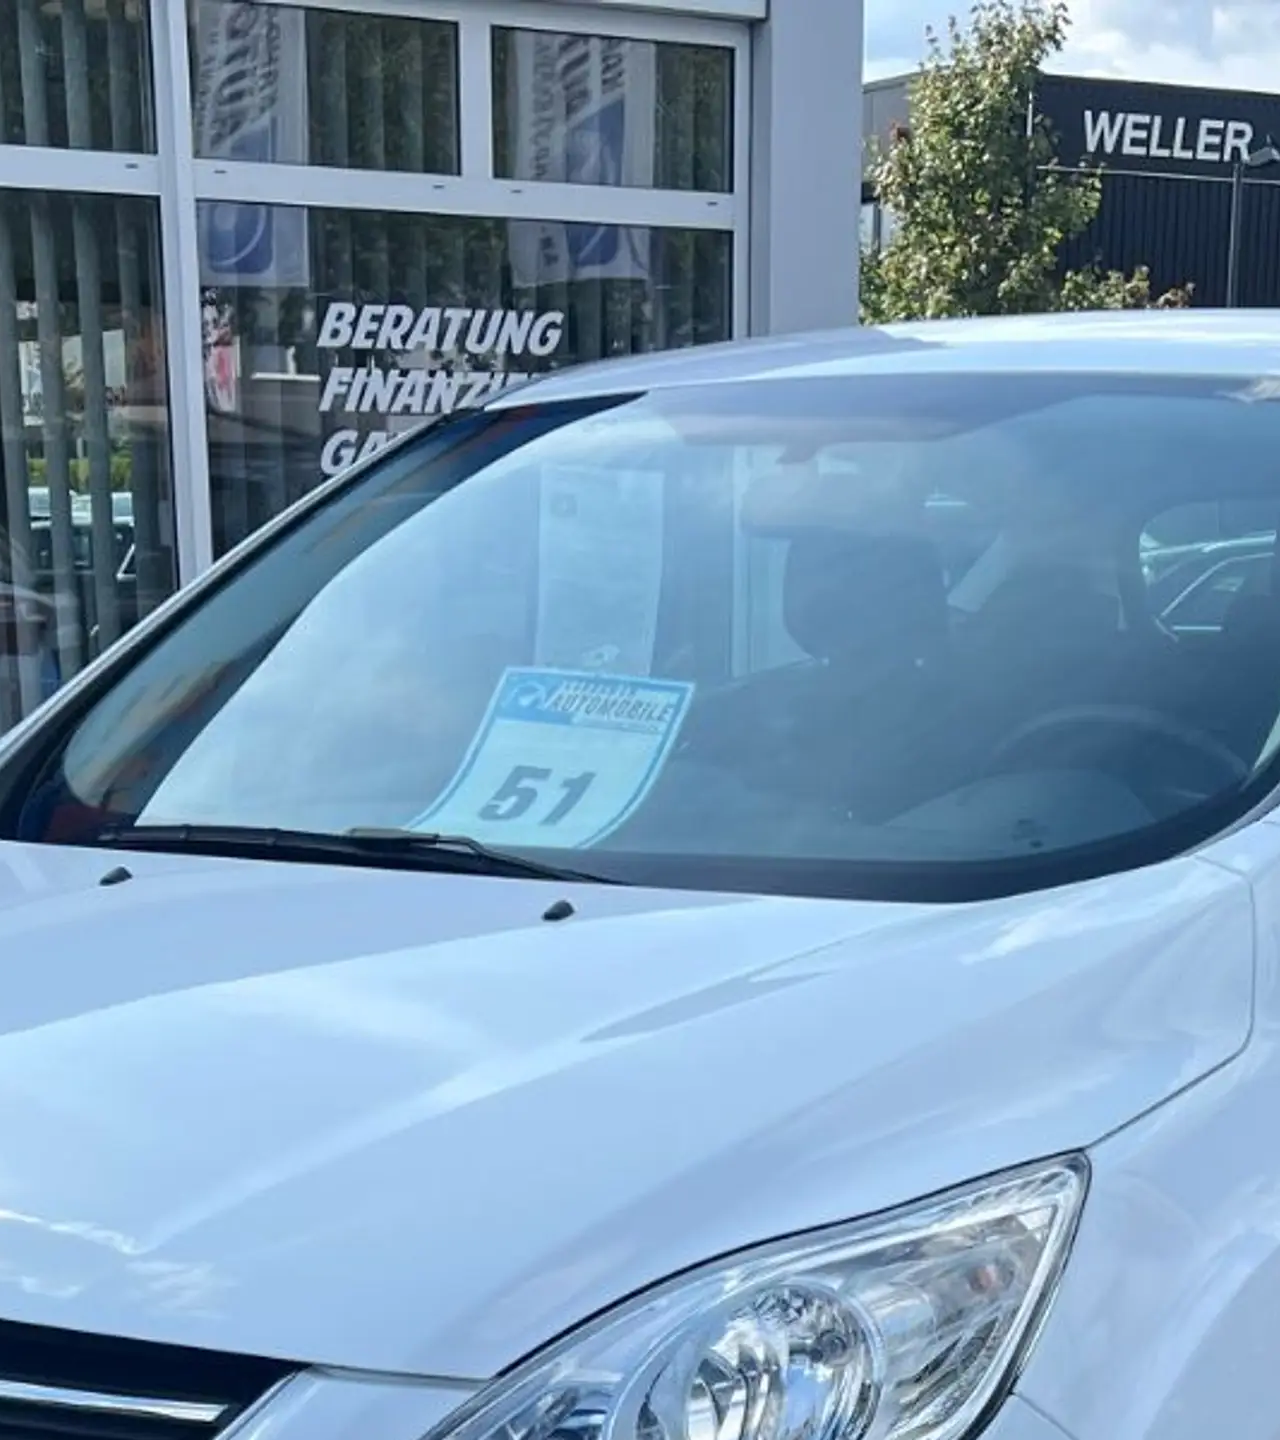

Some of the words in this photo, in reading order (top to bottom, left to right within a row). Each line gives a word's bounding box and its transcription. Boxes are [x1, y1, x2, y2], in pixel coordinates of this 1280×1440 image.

[1084, 110, 1253, 162] WELLER
[317, 302, 565, 355] BERATUNG
[321, 430, 406, 475] GA
[546, 691, 674, 722] AUTOMOBILE
[478, 765, 597, 826] 51
